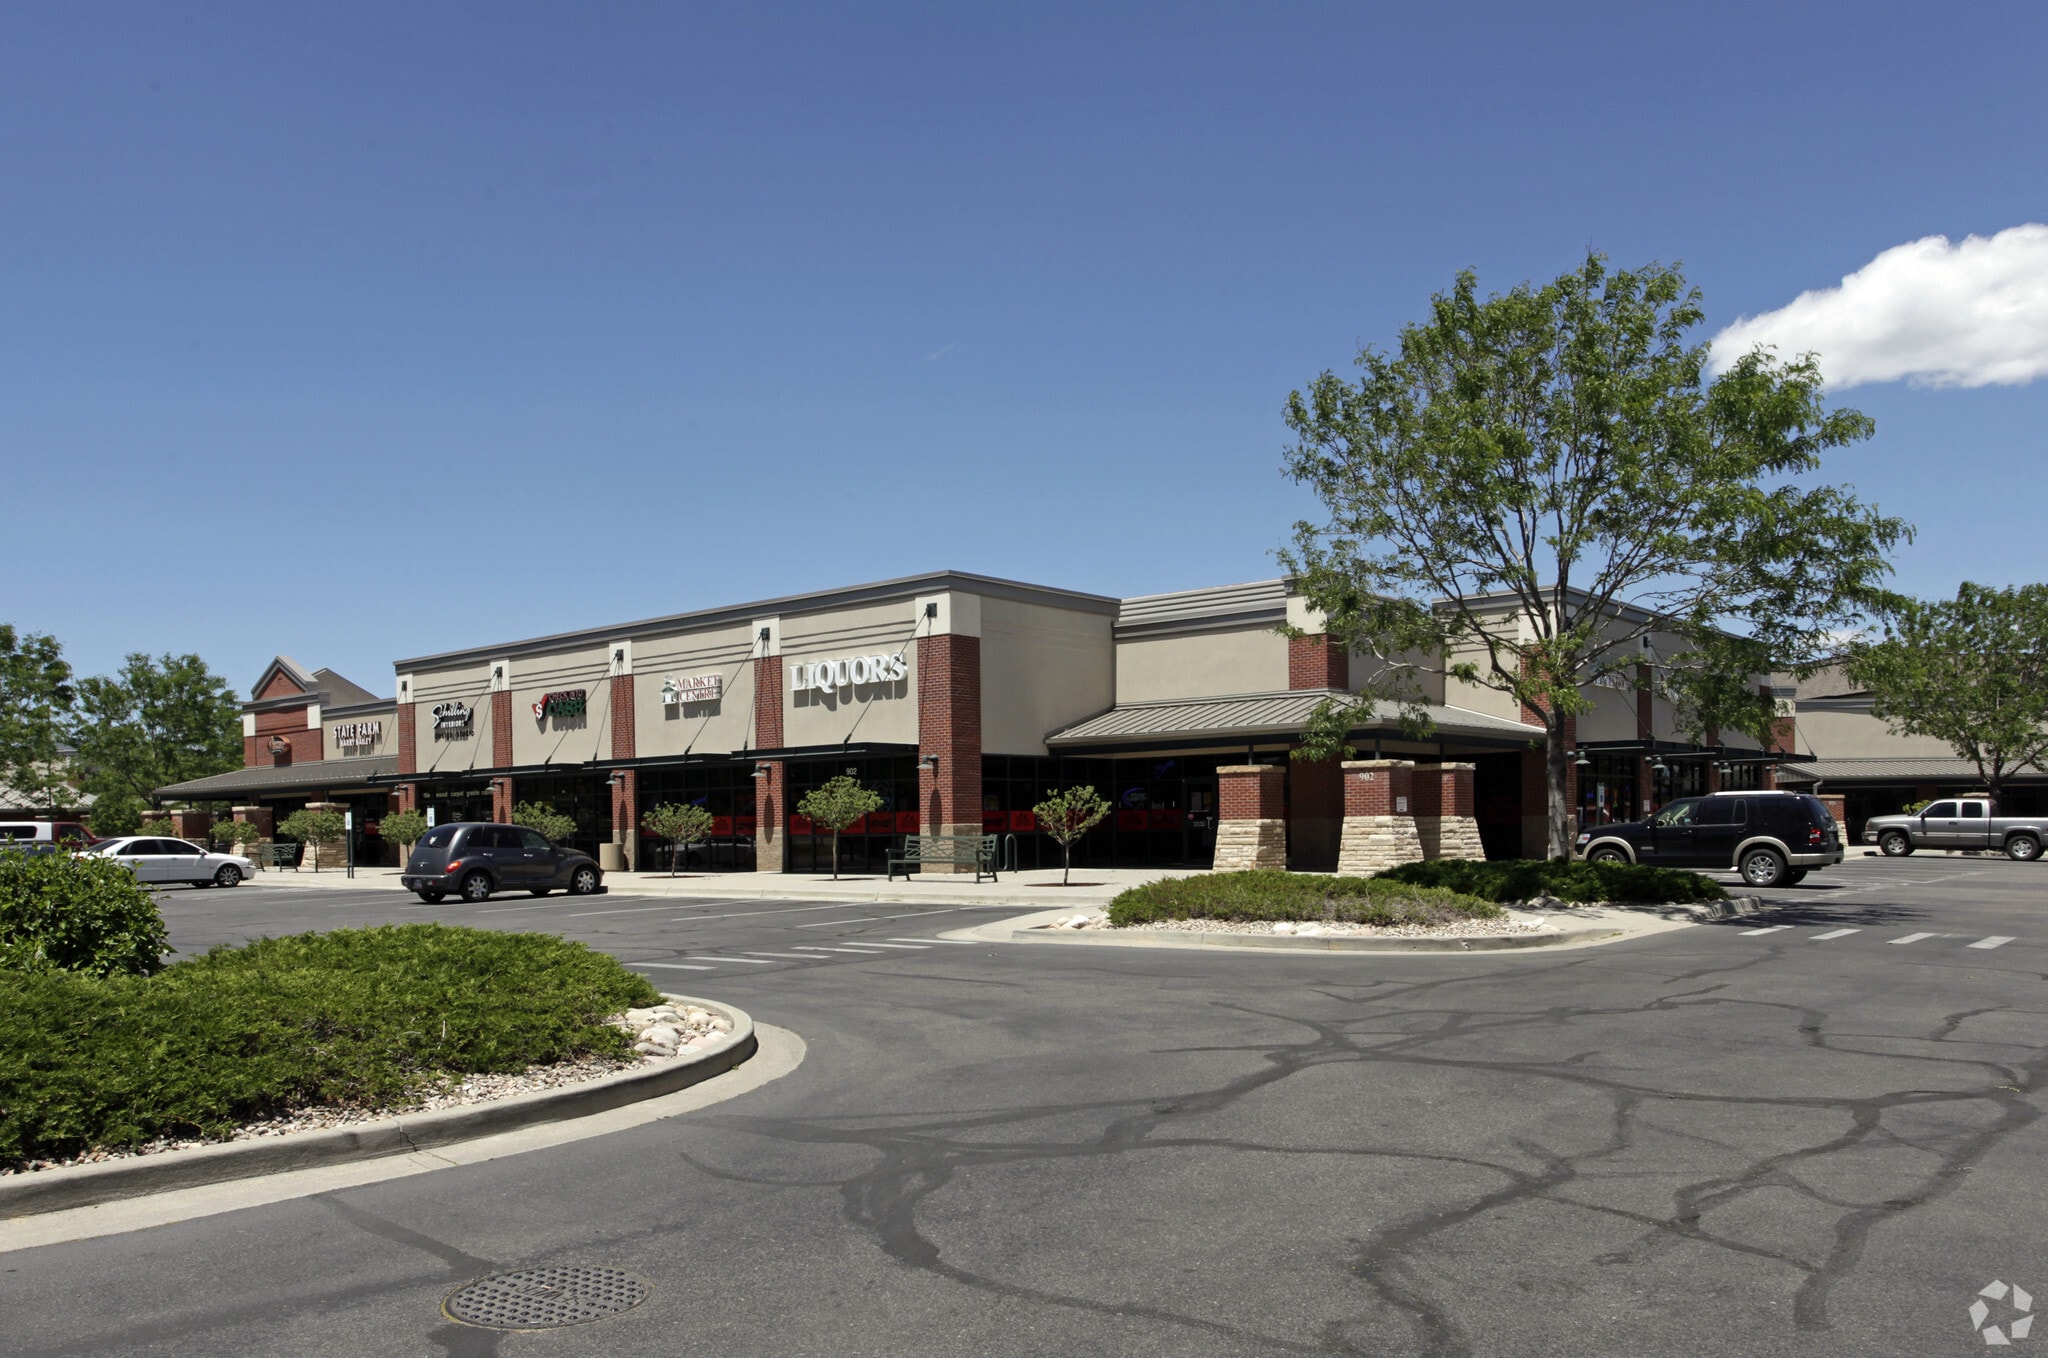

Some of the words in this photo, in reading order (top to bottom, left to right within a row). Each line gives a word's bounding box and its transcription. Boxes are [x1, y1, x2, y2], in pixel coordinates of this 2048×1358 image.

[789, 652, 908, 694] LIQUORS
[677, 675, 720, 690] MARKET
[548, 691, 568, 700] CHECK
[569, 689, 583, 698] INTO
[678, 688, 720, 702] CENTRE
[432, 702, 471, 729] Schilling
[549, 700, 586, 717] CASH
[333, 724, 356, 738] STATE
[358, 721, 380, 735] FARM
[440, 720, 465, 728] INTERIORS
[846, 767, 857, 775] 902
[1359, 772, 1374, 781] 902
